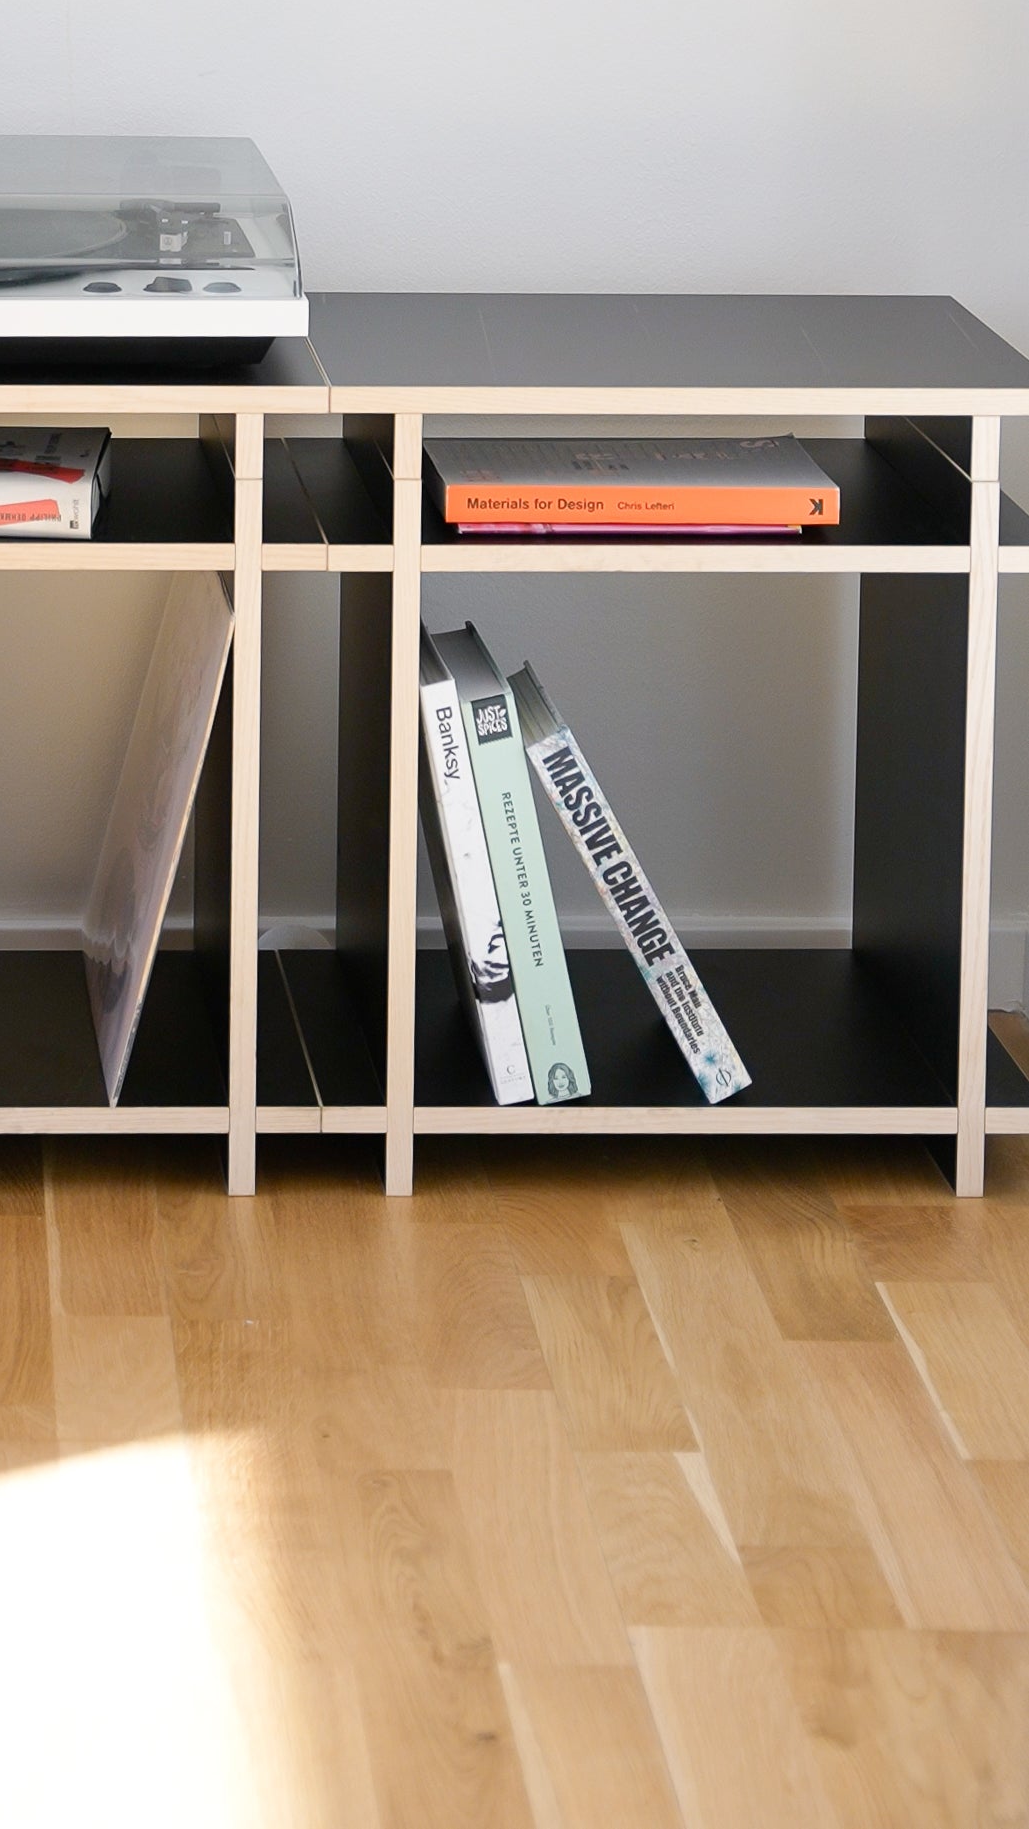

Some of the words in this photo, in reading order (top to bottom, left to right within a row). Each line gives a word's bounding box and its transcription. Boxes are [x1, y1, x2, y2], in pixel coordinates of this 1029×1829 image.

[467, 497, 530, 510] Materials
[534, 497, 553, 510] for
[557, 498, 604, 513] Design
[617, 501, 642, 510] Chris
[645, 501, 675, 510] Lefteri
[809, 499, 824, 515] K
[476, 705, 501, 724] JUST
[478, 718, 508, 736] SPICES
[436, 706, 460, 779] Banksy
[502, 792, 520, 844] REZEPTE
[512, 847, 529, 888] UNTER
[542, 746, 623, 867] MASSIVE
[602, 860, 675, 967] CHANGE
[520, 892, 532, 907] 30
[525, 910, 543, 968] MINUTEN
[665, 971, 679, 989] and
[674, 986, 686, 1002] the
[682, 1001, 704, 1037] Institute
[675, 965, 692, 991] Bruce
[688, 990, 702, 1009] Mau
[656, 975, 677, 1008] without
[672, 1006, 700, 1054] Boundaries
